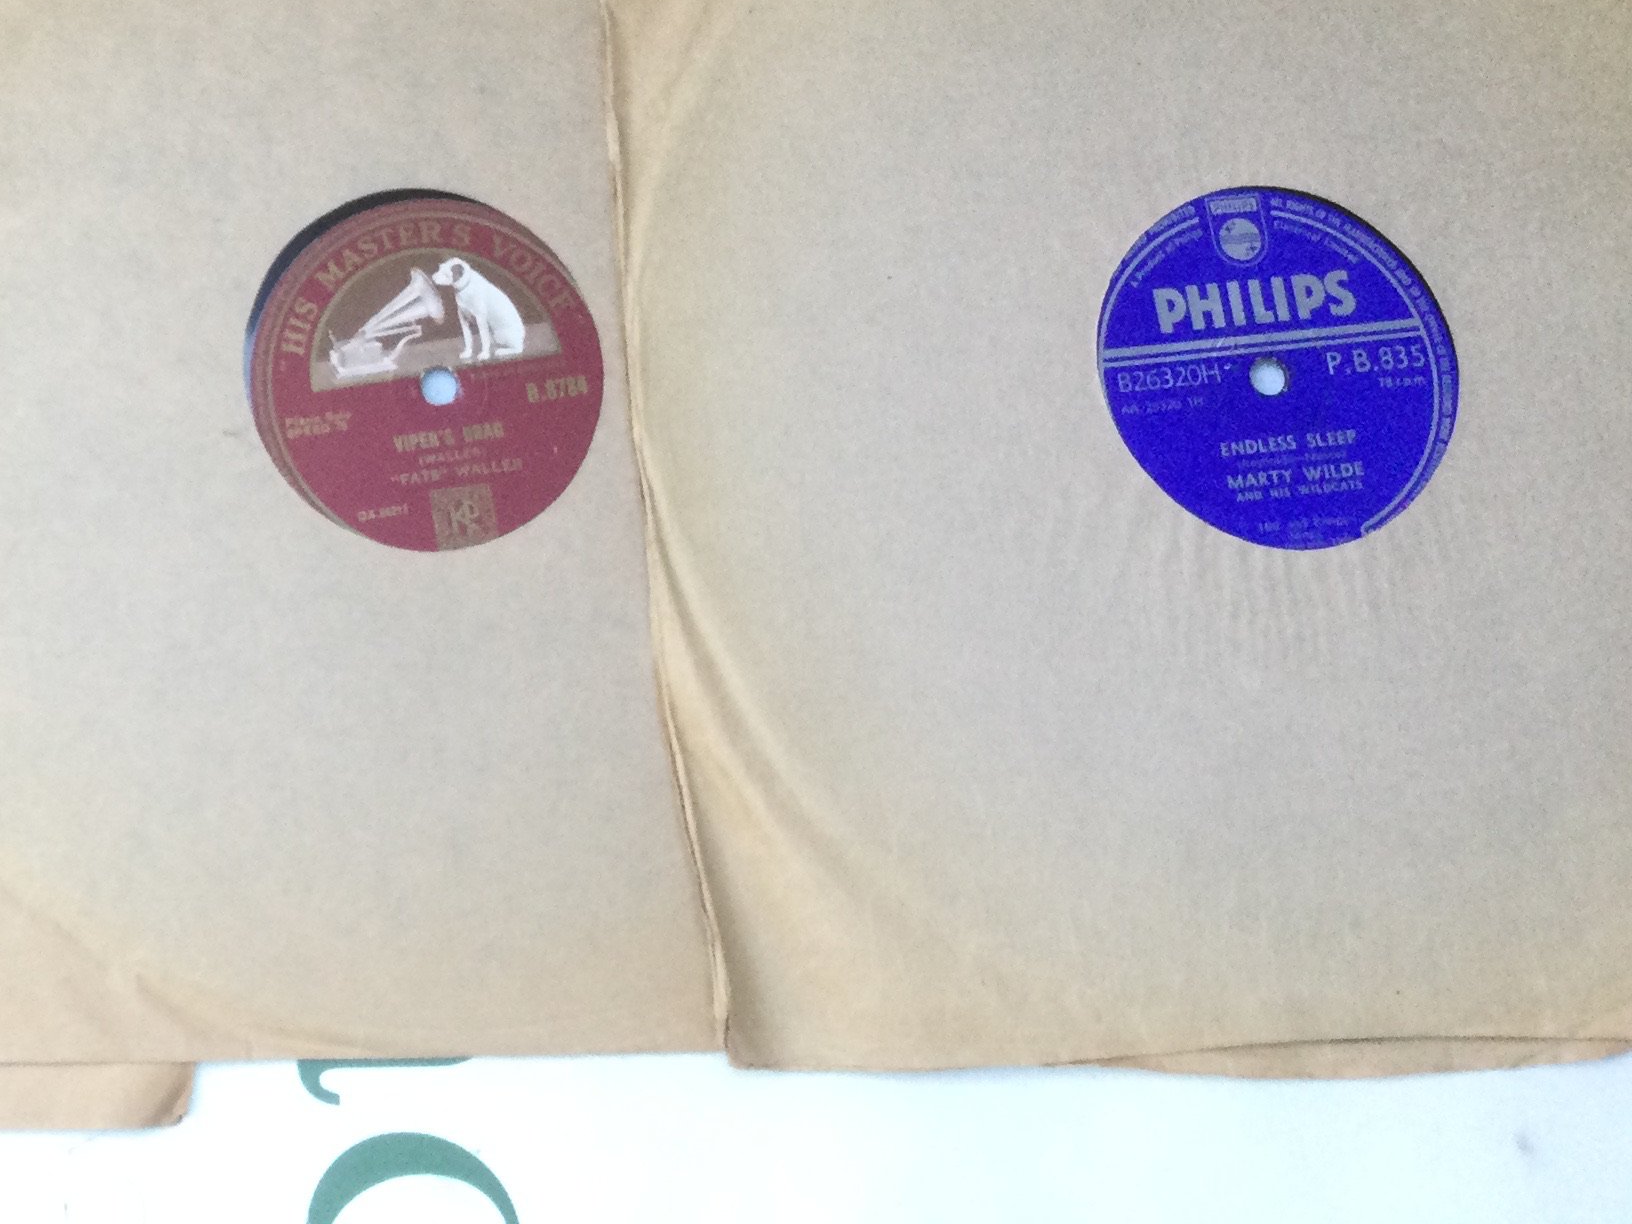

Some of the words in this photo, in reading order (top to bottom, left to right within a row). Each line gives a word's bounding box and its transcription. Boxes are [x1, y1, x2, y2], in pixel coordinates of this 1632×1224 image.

[1152, 269, 1358, 334] PHILIPS
[1325, 344, 1426, 376] P.B.835
[1219, 434, 1297, 457] ENDLESS
[1305, 428, 1357, 449] SLEEP
[1226, 468, 1293, 489] MARTY
[1301, 460, 1365, 482] WILDE
